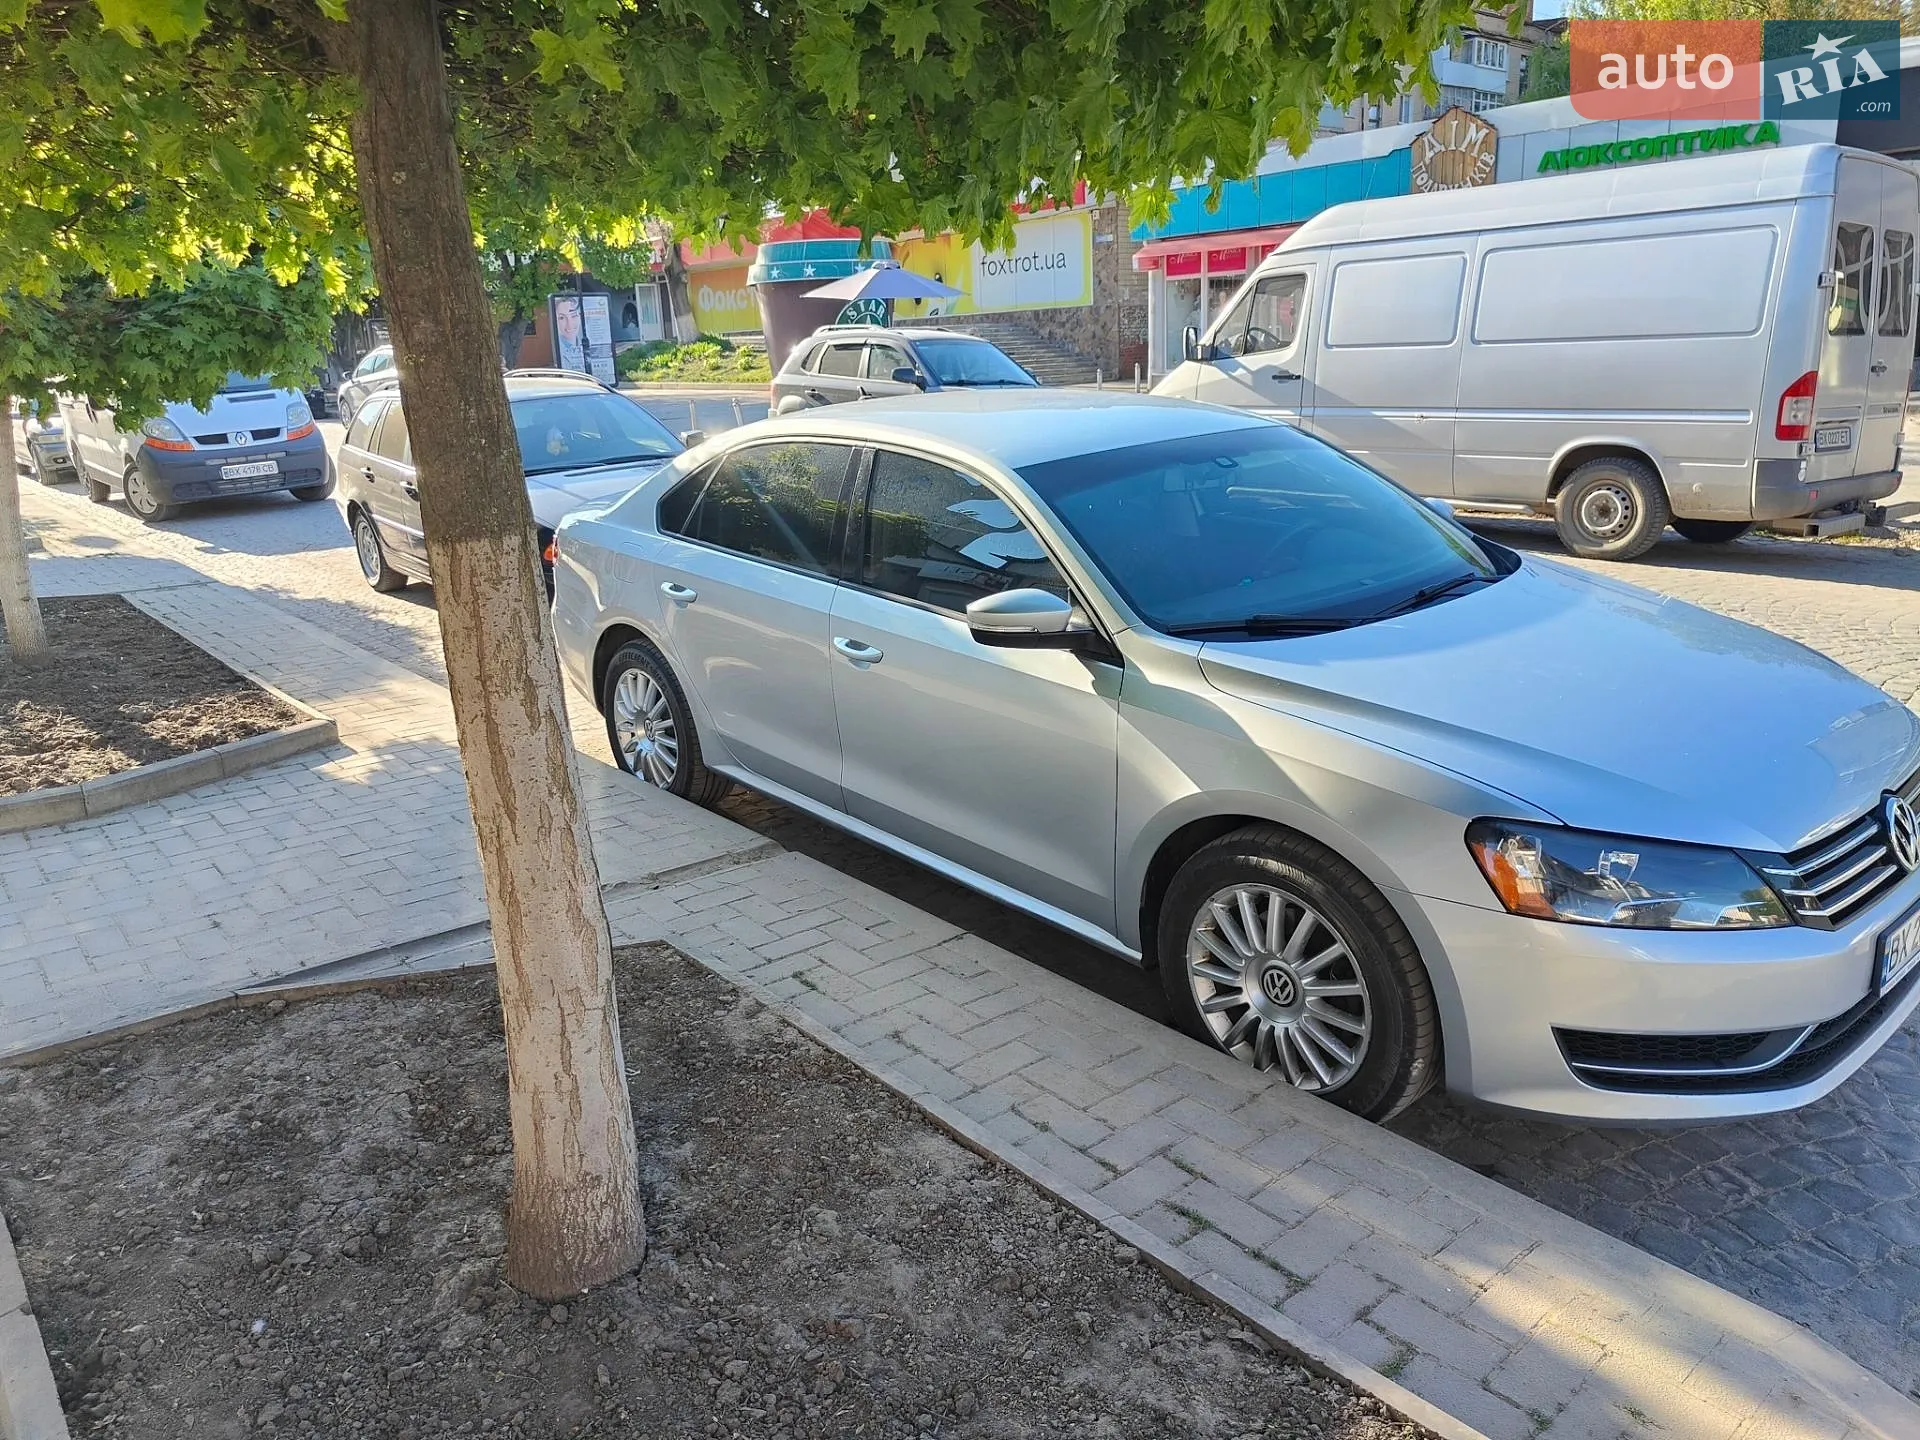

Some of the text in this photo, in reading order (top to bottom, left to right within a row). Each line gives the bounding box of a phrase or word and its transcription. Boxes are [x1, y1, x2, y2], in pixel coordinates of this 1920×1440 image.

[1422, 120, 1490, 165] ДІМ
[1536, 120, 1781, 173] ЛЮКСОПТИКА
[981, 250, 1067, 277] foxtrot.ua
